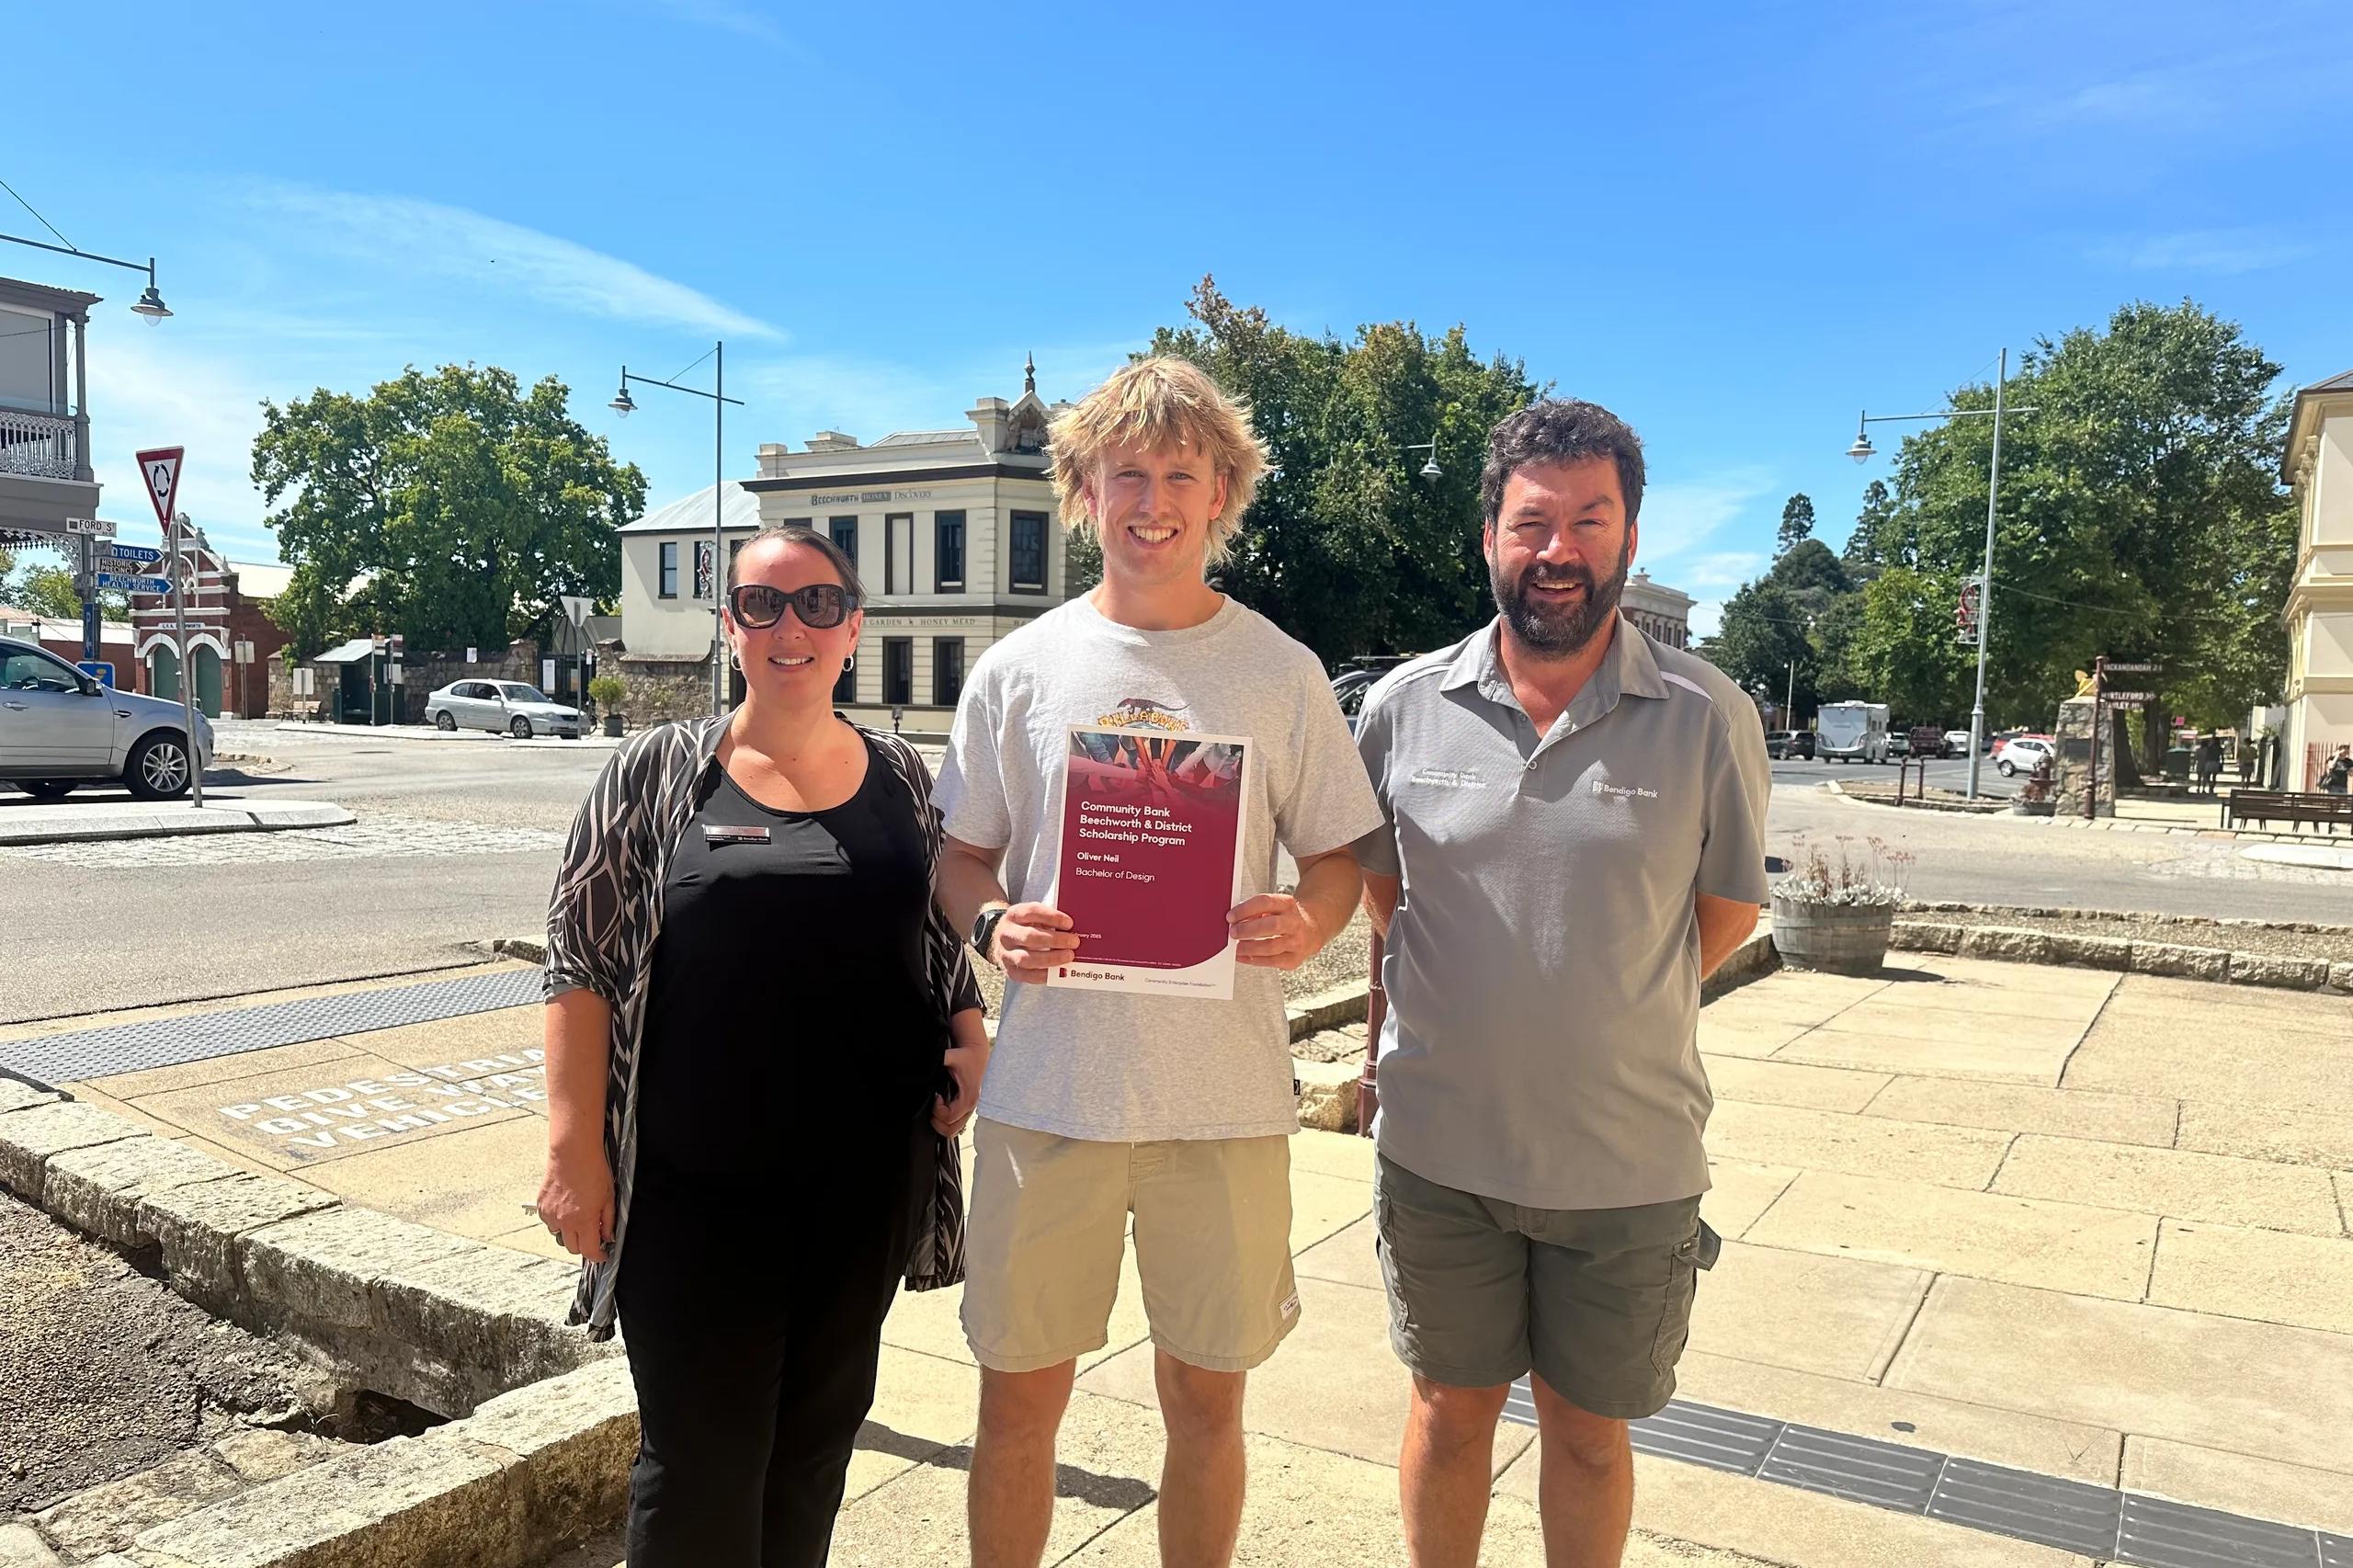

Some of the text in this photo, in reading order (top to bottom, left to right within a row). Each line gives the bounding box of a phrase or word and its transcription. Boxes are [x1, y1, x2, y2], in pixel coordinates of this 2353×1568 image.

[79, 519, 102, 530] FORD
[119, 548, 154, 561] TOILETS
[100, 564, 133, 574] PRECINCT
[101, 558, 132, 568] HISTORIC
[109, 574, 154, 585] BEECHWORTH
[102, 580, 161, 593] HEALTH SERVICE
[869, 618, 903, 626] GARDEN
[920, 618, 949, 626] HONEY
[952, 617, 976, 626] MEAD
[1604, 784, 1658, 798] Bendigo Bank
[1081, 801, 1170, 817] Community Bank
[1080, 814, 1192, 833] Beechworth & District
[1079, 828, 1186, 846] Scholarship Program
[1076, 852, 1120, 863] Oliver Neil
[1075, 867, 1155, 883] Bachelor of Design
[1071, 970, 1125, 982] Bendigo Bank
[216, 1048, 545, 1120] PEDESTRIA
[253, 1095, 417, 1134] GIVE
[286, 1086, 550, 1148] VEHICLE
